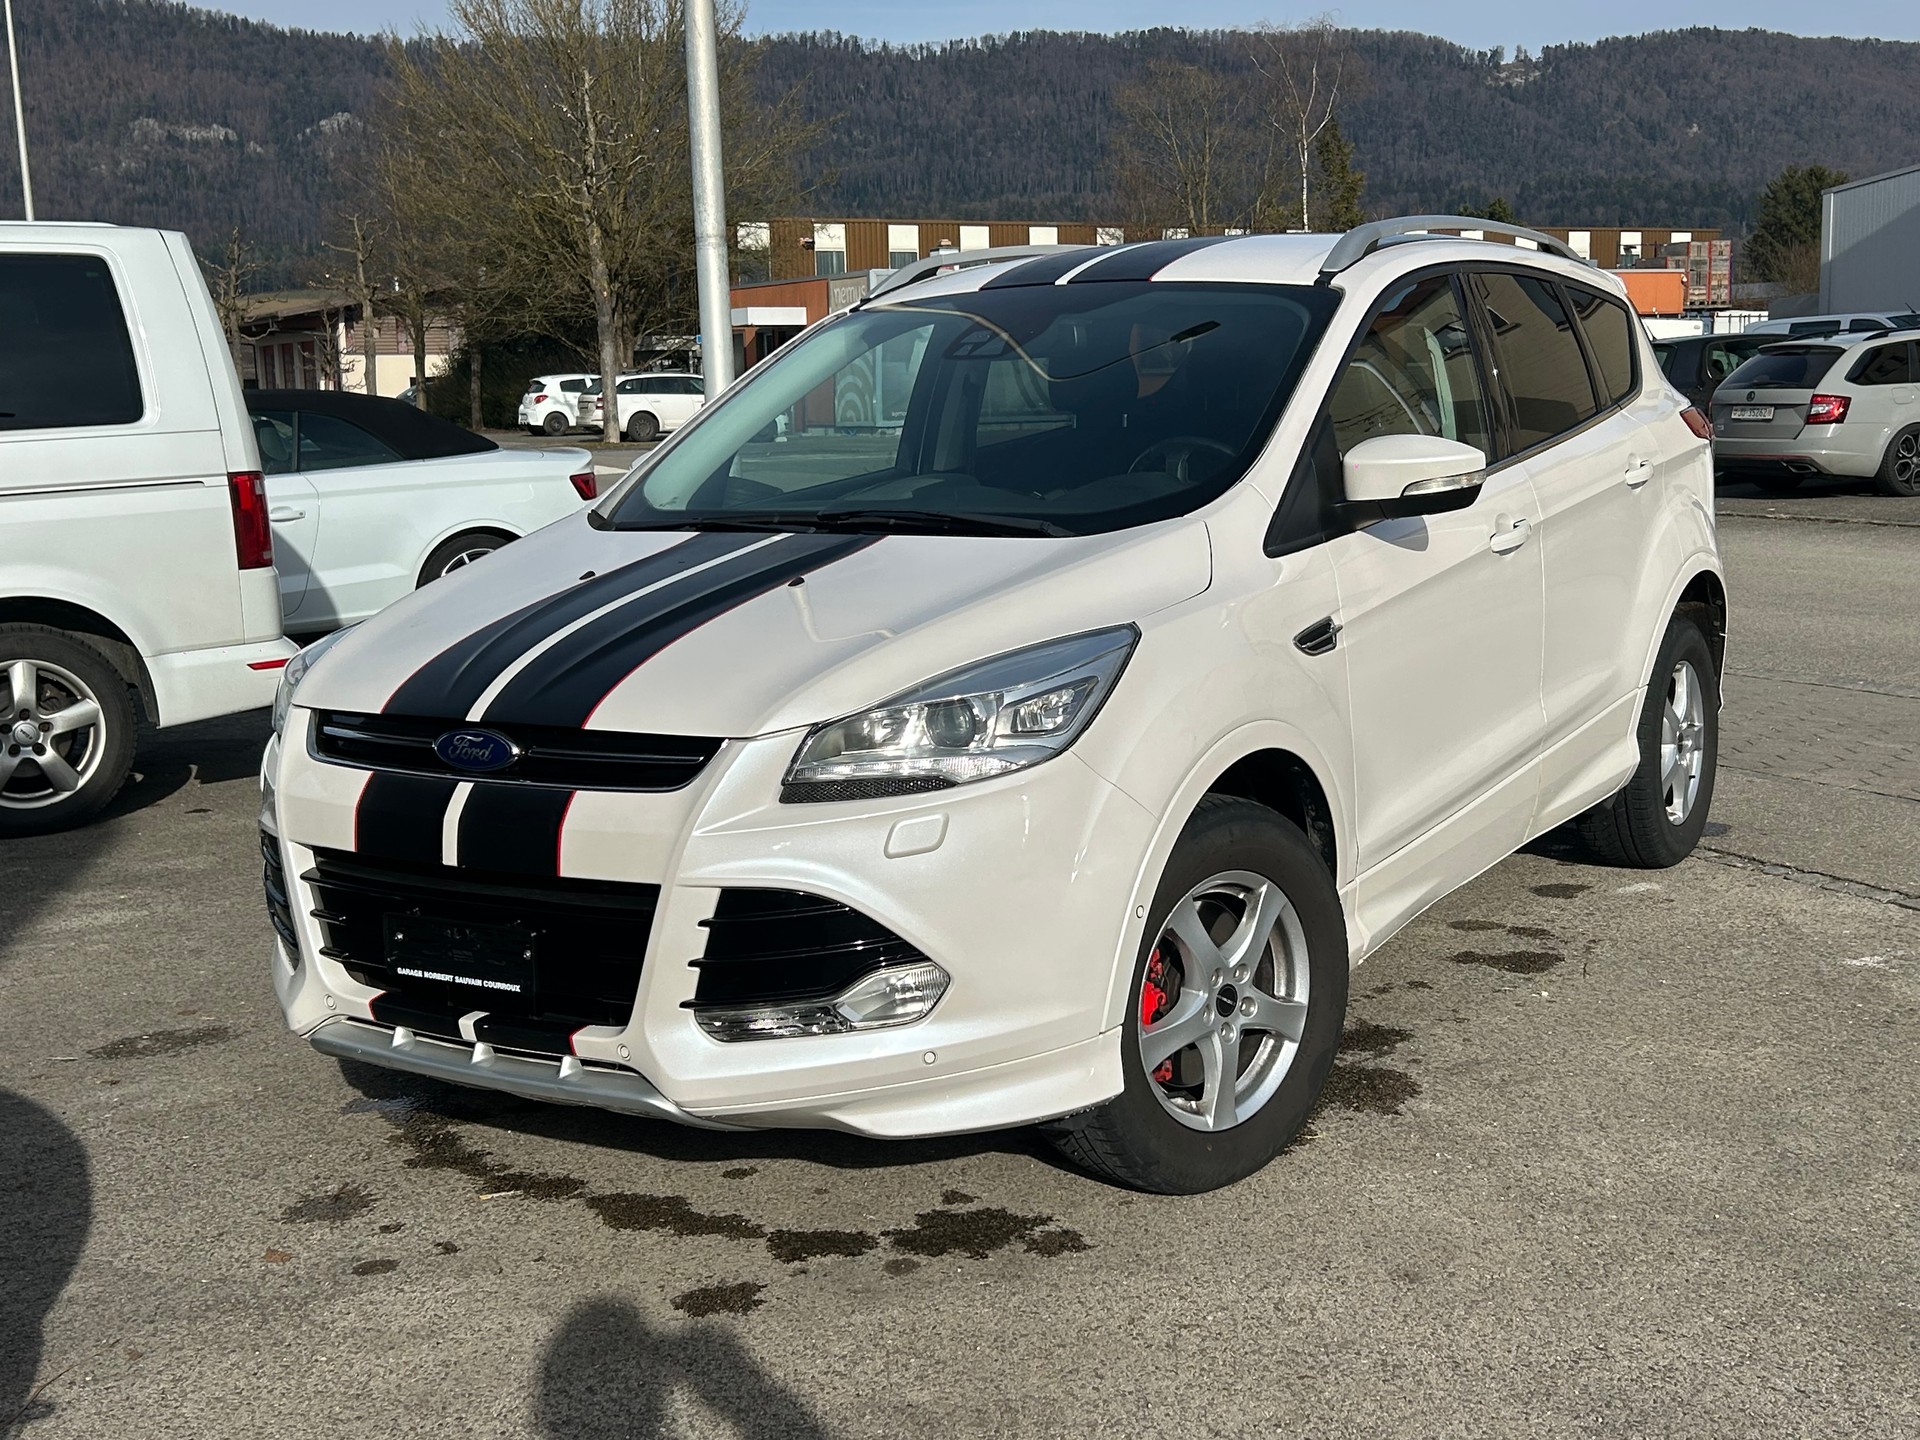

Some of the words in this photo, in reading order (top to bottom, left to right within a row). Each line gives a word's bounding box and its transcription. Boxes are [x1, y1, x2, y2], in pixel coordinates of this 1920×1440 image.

[448, 735, 495, 761] Ford
[397, 967, 423, 977] GARAGE
[423, 971, 454, 982] NORBERT
[454, 975, 482, 987] SAUVAIN
[483, 980, 521, 992] COURROUX
